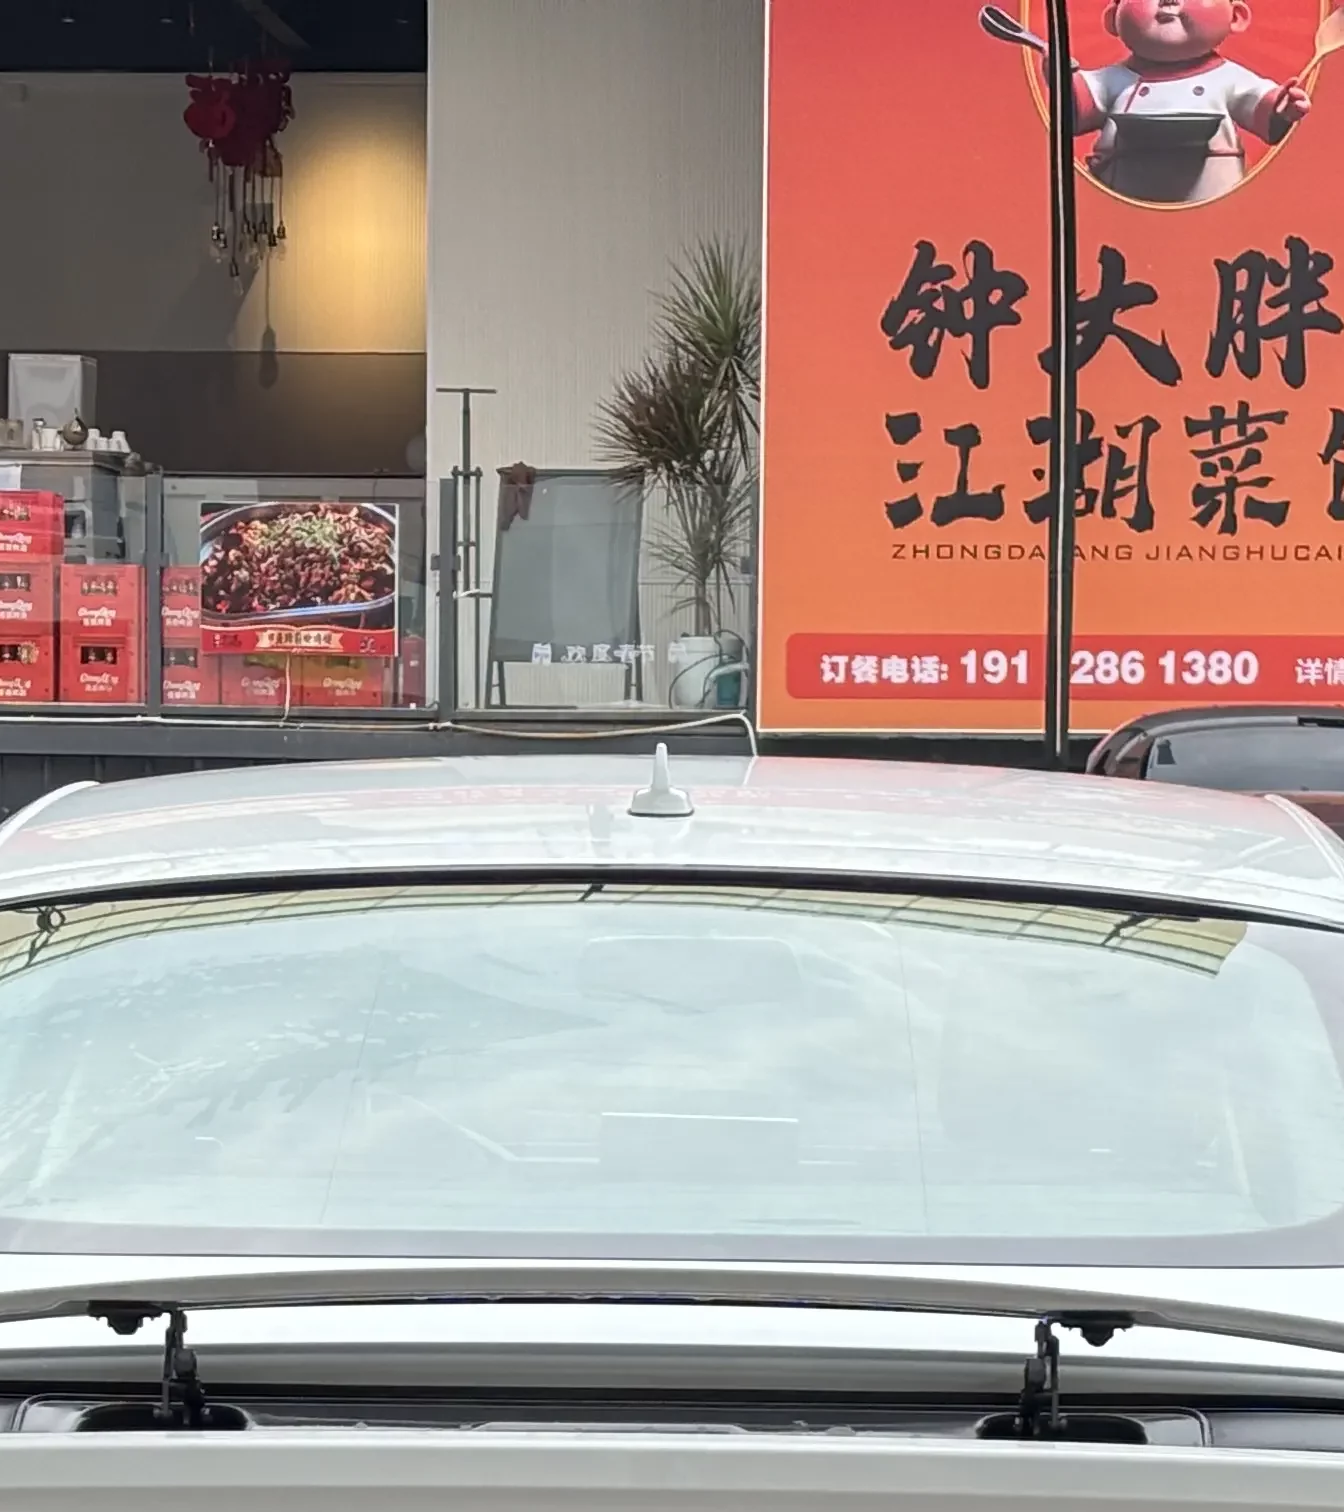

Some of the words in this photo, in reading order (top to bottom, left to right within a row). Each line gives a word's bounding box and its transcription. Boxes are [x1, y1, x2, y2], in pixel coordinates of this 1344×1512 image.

[880, 236, 1344, 389] 钟大胖
[892, 544, 1133, 561] ZHONGDAANG
[821, 654, 948, 684] 订餐电话:
[960, 650, 1028, 684] 191
[1159, 650, 1258, 685] 1380
